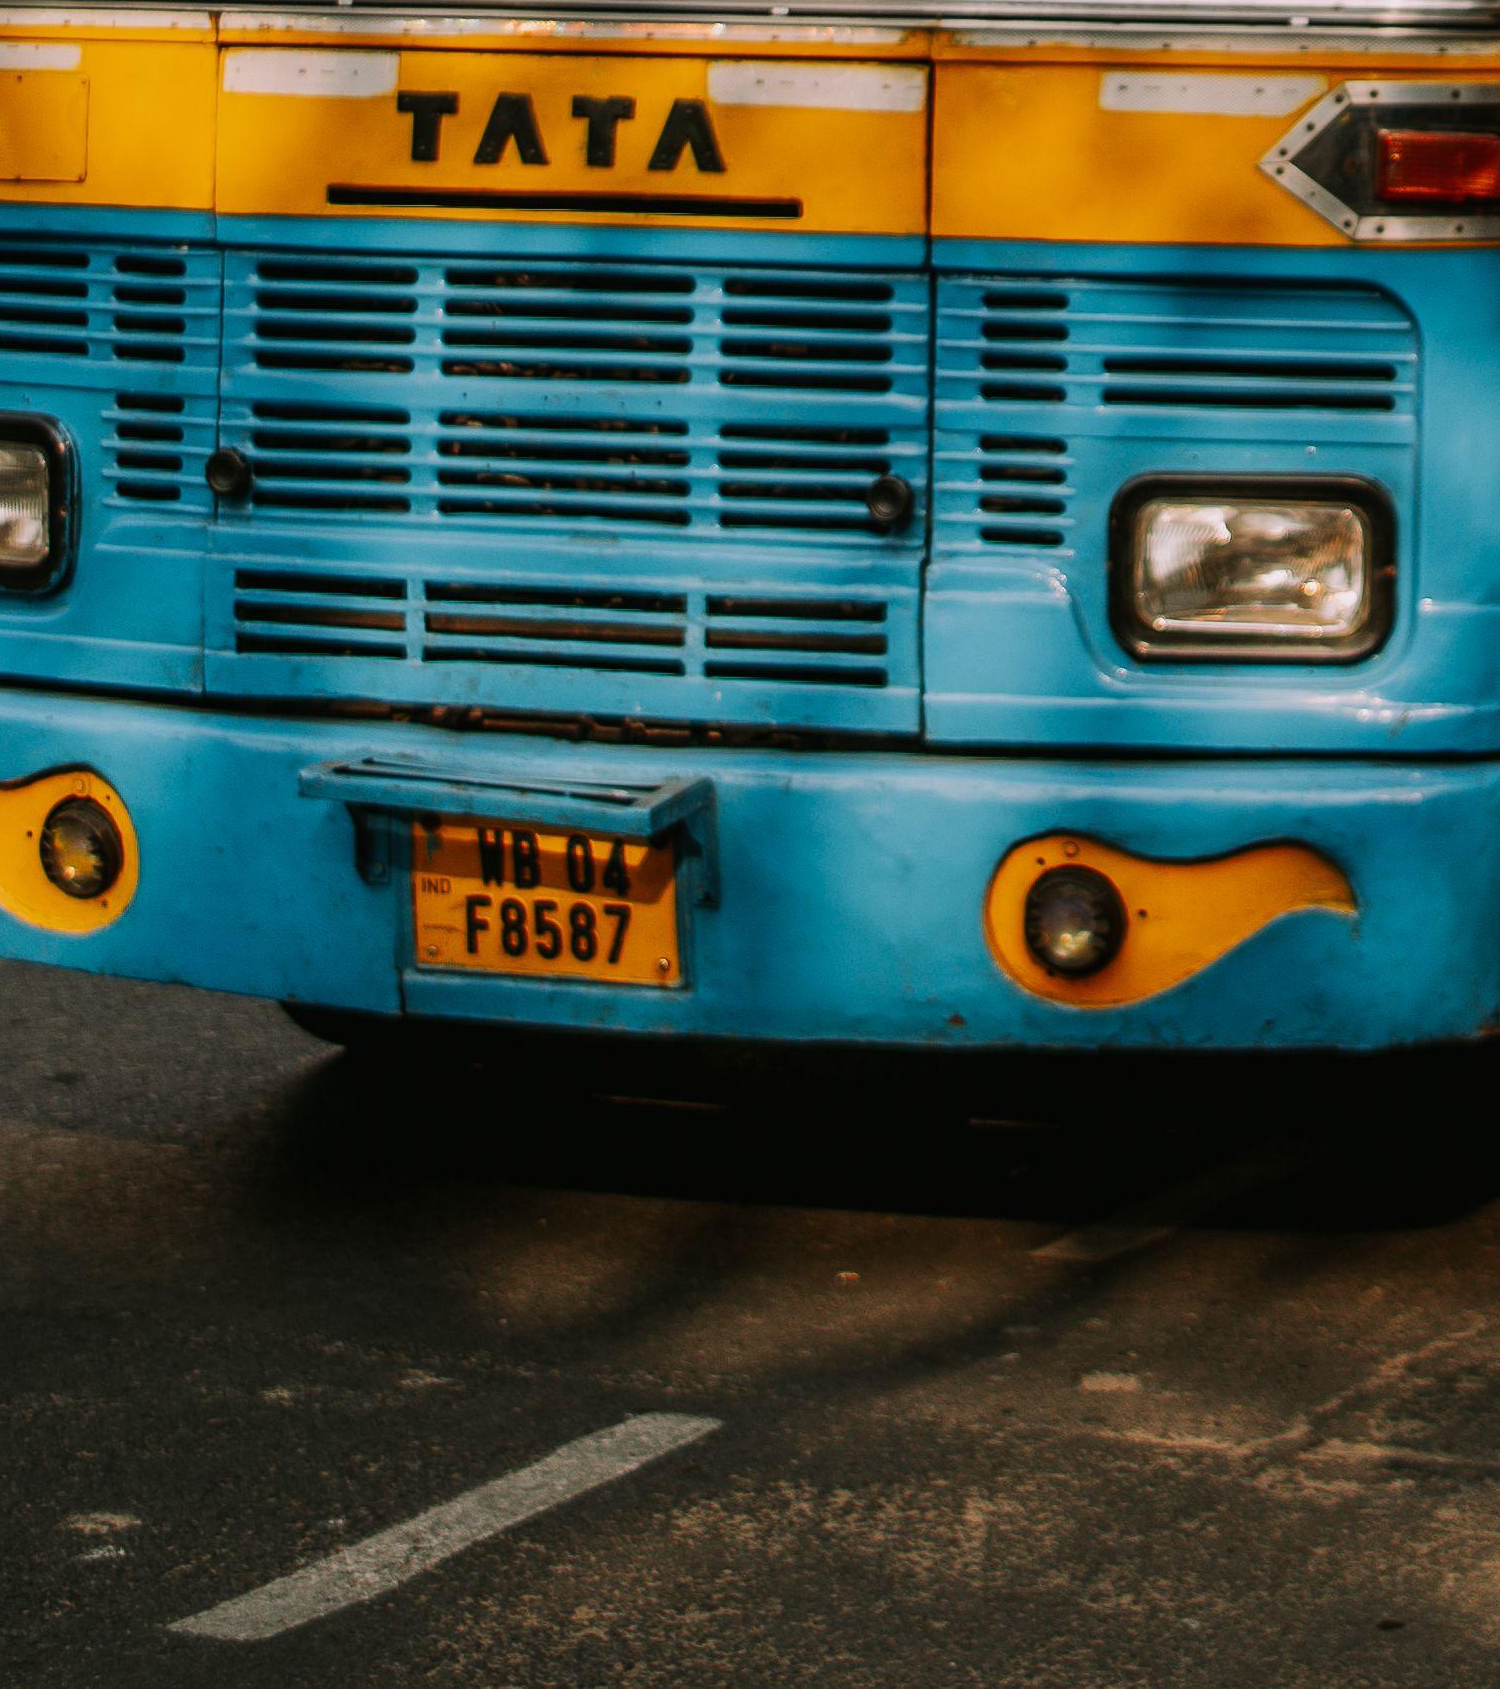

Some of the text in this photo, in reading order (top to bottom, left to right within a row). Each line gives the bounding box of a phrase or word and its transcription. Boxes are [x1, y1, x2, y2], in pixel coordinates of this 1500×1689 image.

[396, 90, 728, 174] TATA
[421, 877, 451, 894] IND
[477, 826, 631, 897] WB 04
[465, 893, 632, 965] F8587
